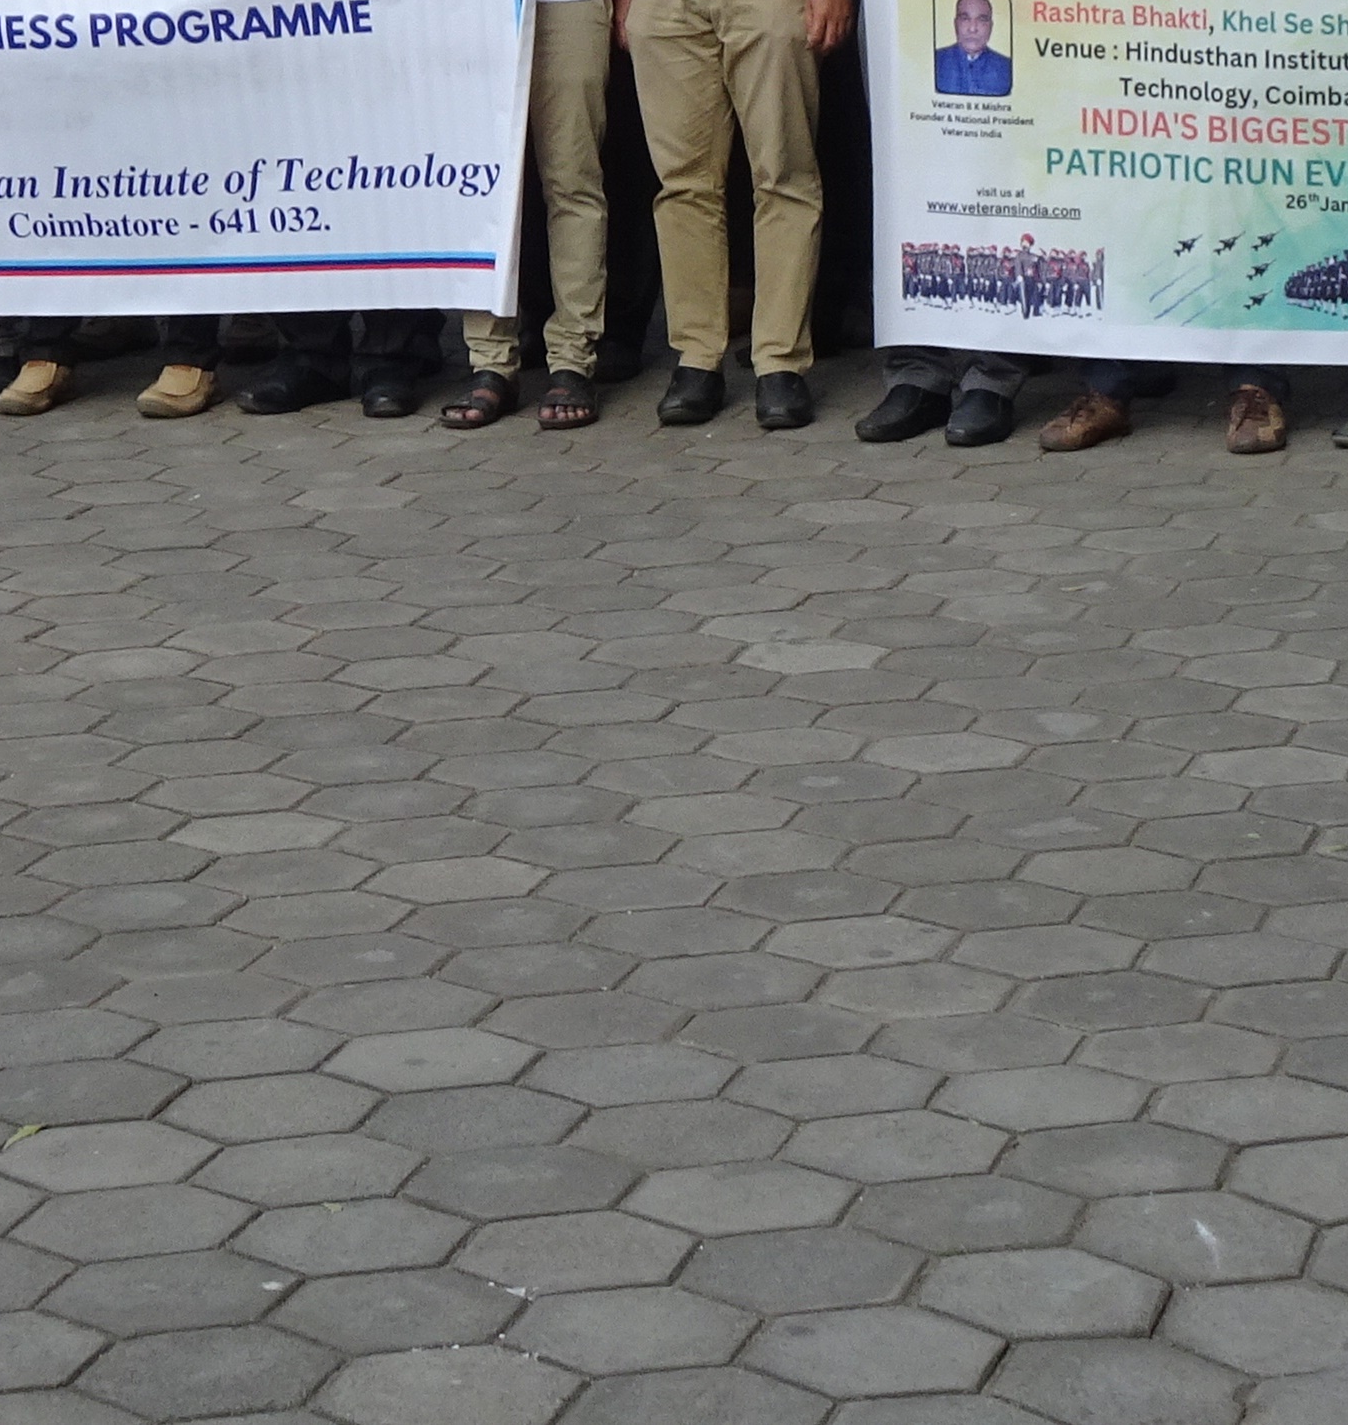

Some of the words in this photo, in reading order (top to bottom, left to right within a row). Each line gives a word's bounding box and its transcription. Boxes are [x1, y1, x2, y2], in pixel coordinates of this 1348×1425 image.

[90, 0, 373, 48] PROGRAMME
[1033, 1, 1125, 27] Rashtra
[1132, 5, 1215, 36] Bhakti,
[1222, 9, 1276, 34] Khel
[1284, 11, 1313, 35] Se
[1034, 37, 1106, 60] Venue
[1126, 41, 1257, 69] Hindusthan
[982, 102, 1012, 112] Mishra
[1120, 76, 1258, 110] Technology,
[909, 112, 945, 122] Founder
[947, 114, 953, 122] &
[954, 114, 991, 125] National
[992, 116, 1035, 126] President
[941, 127, 978, 138] Veterans
[979, 128, 1002, 139] India
[1081, 107, 1199, 141] INDIA'S
[52, 164, 209, 199] Institute
[223, 158, 266, 203] of
[276, 152, 502, 198] Technology
[1046, 147, 1213, 185] PATRIOTIC
[1223, 158, 1294, 187] RUN
[976, 187, 998, 198] visit
[999, 189, 1012, 198] us
[1015, 188, 1025, 198] at
[8, 212, 181, 238] Coimbatore
[208, 208, 260, 235] 641
[269, 206, 331, 233] 032.
[927, 200, 1081, 220] www.veteransindia.com
